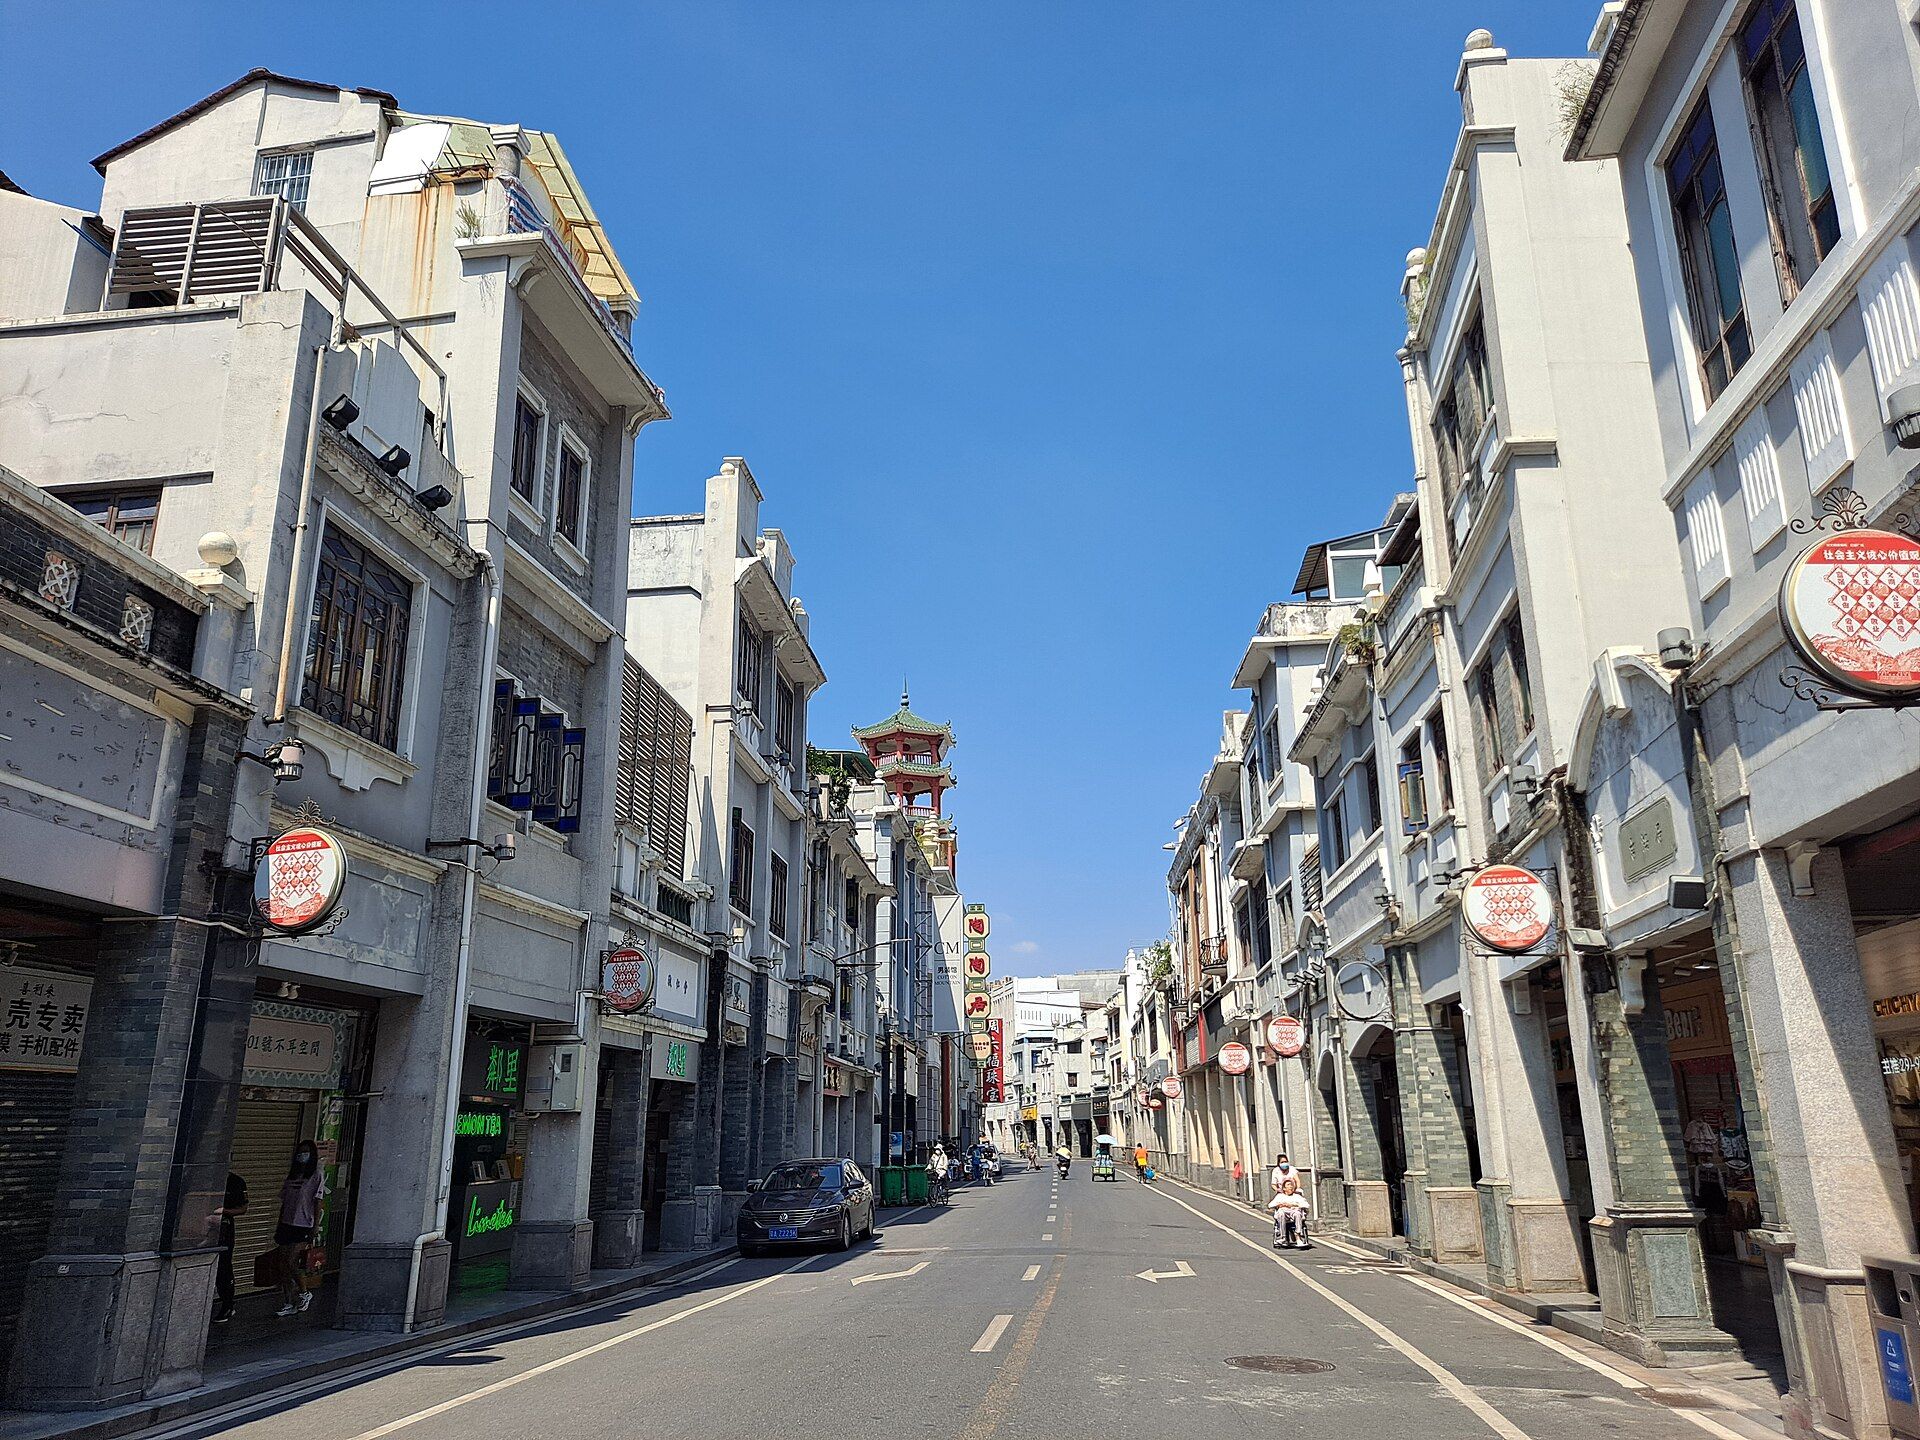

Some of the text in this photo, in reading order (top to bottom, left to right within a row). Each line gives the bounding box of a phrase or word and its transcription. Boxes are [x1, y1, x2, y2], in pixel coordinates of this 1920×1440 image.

[934, 941, 960, 955] CM
[967, 916, 988, 1016] 陶陶居
[18, 1033, 80, 1058] 手机配件
